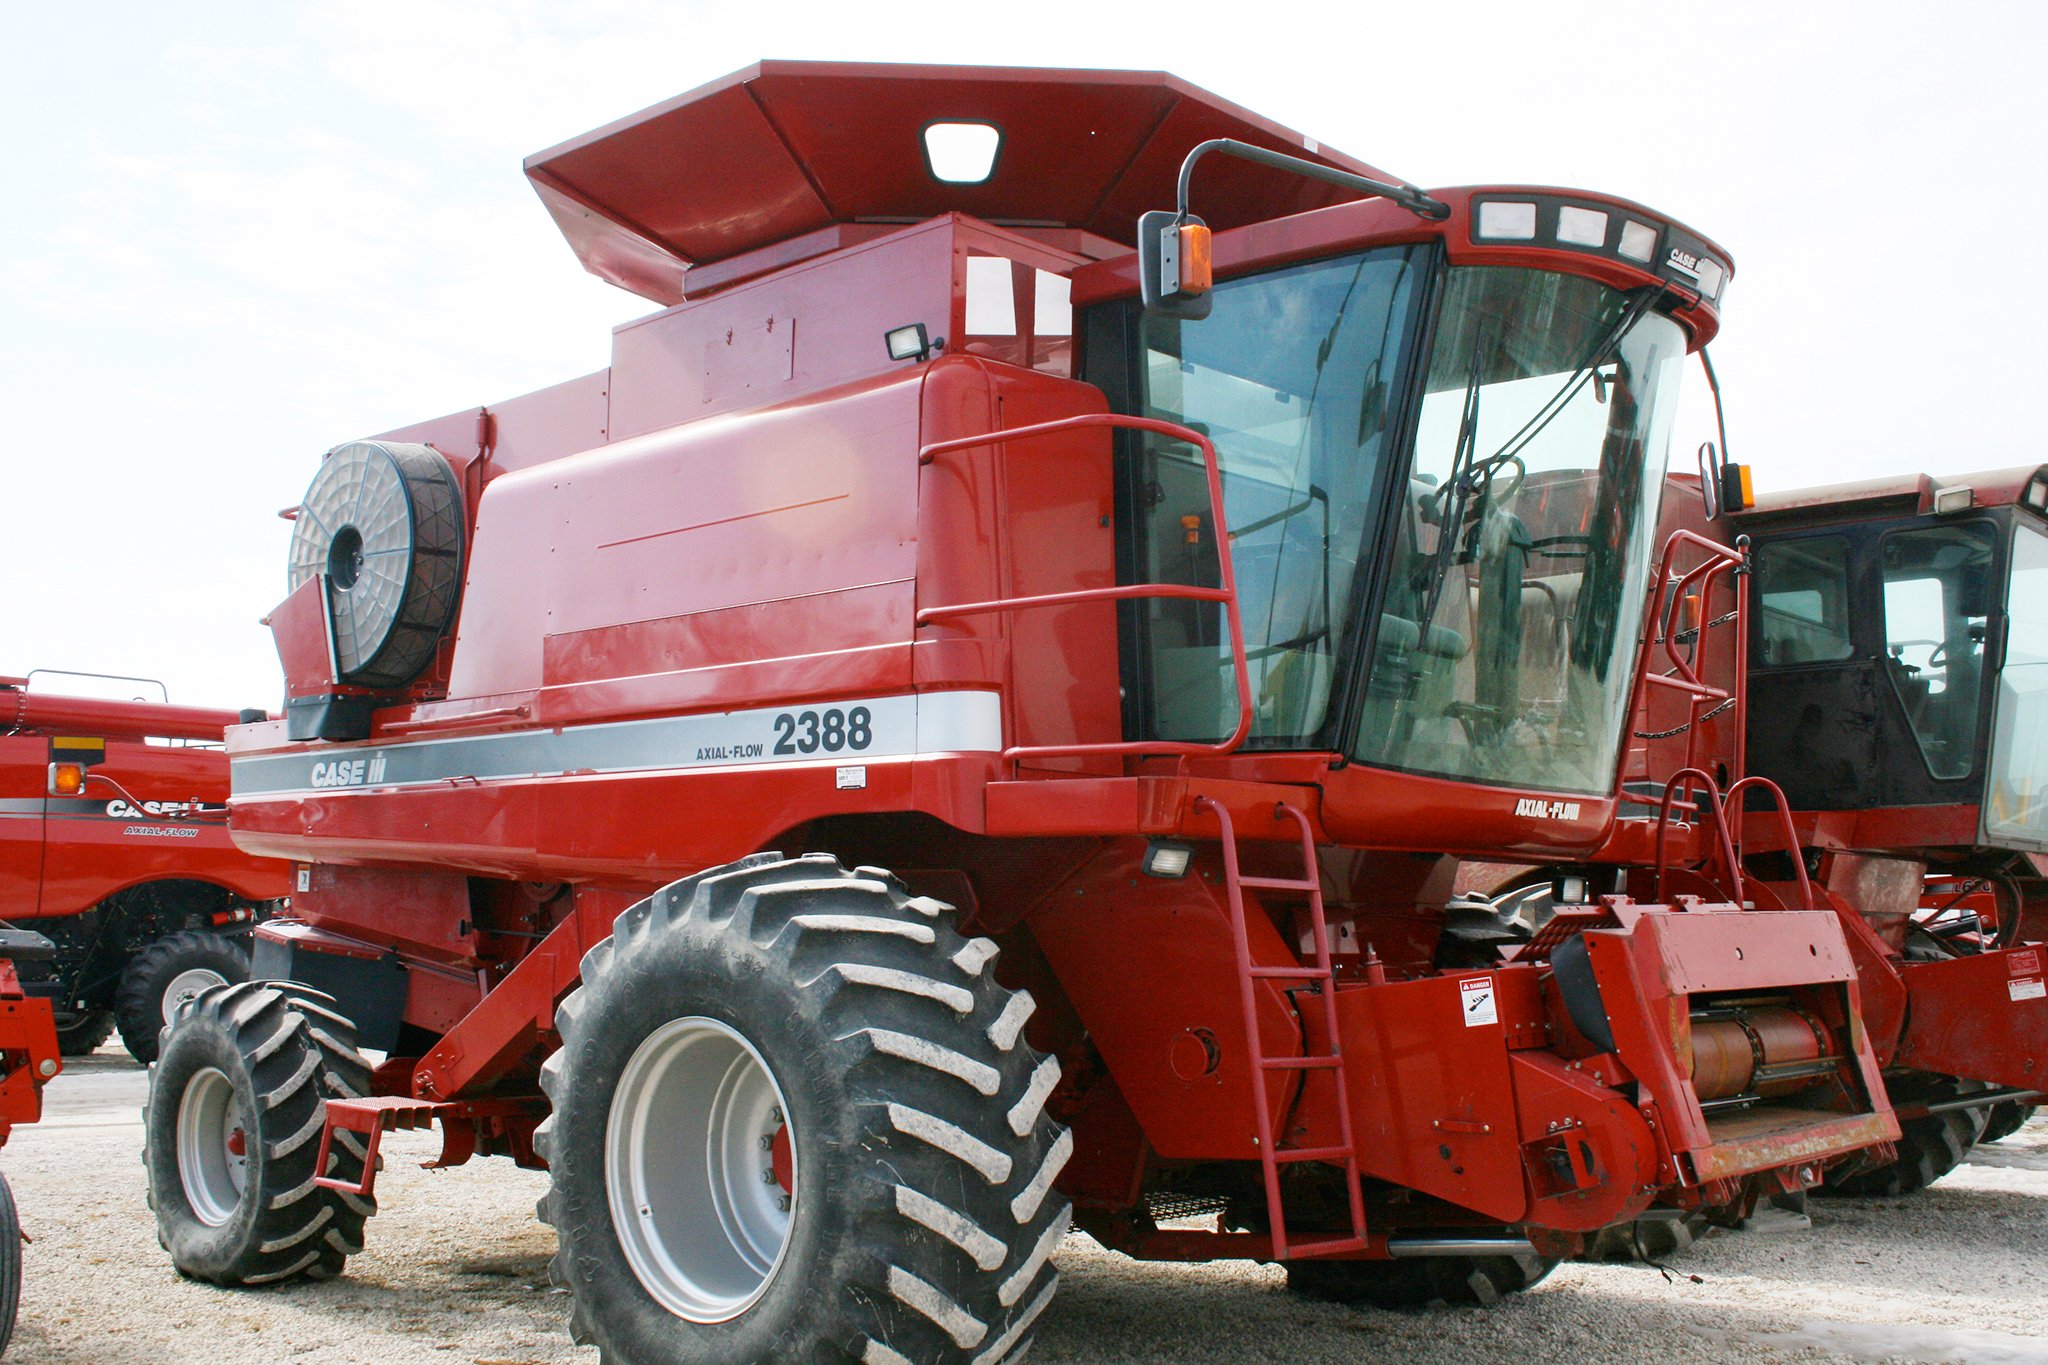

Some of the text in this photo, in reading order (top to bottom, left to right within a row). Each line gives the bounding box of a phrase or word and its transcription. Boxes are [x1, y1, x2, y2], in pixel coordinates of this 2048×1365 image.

[1670, 248, 1697, 269] CASE
[773, 706, 872, 756] 2388
[696, 744, 763, 761] AXIAL-FLOW
[311, 760, 366, 788] CASE
[106, 799, 180, 818] CASE
[1514, 798, 1581, 821] AXIAL-FLOW
[124, 826, 199, 838] AXIAL-FLOW
